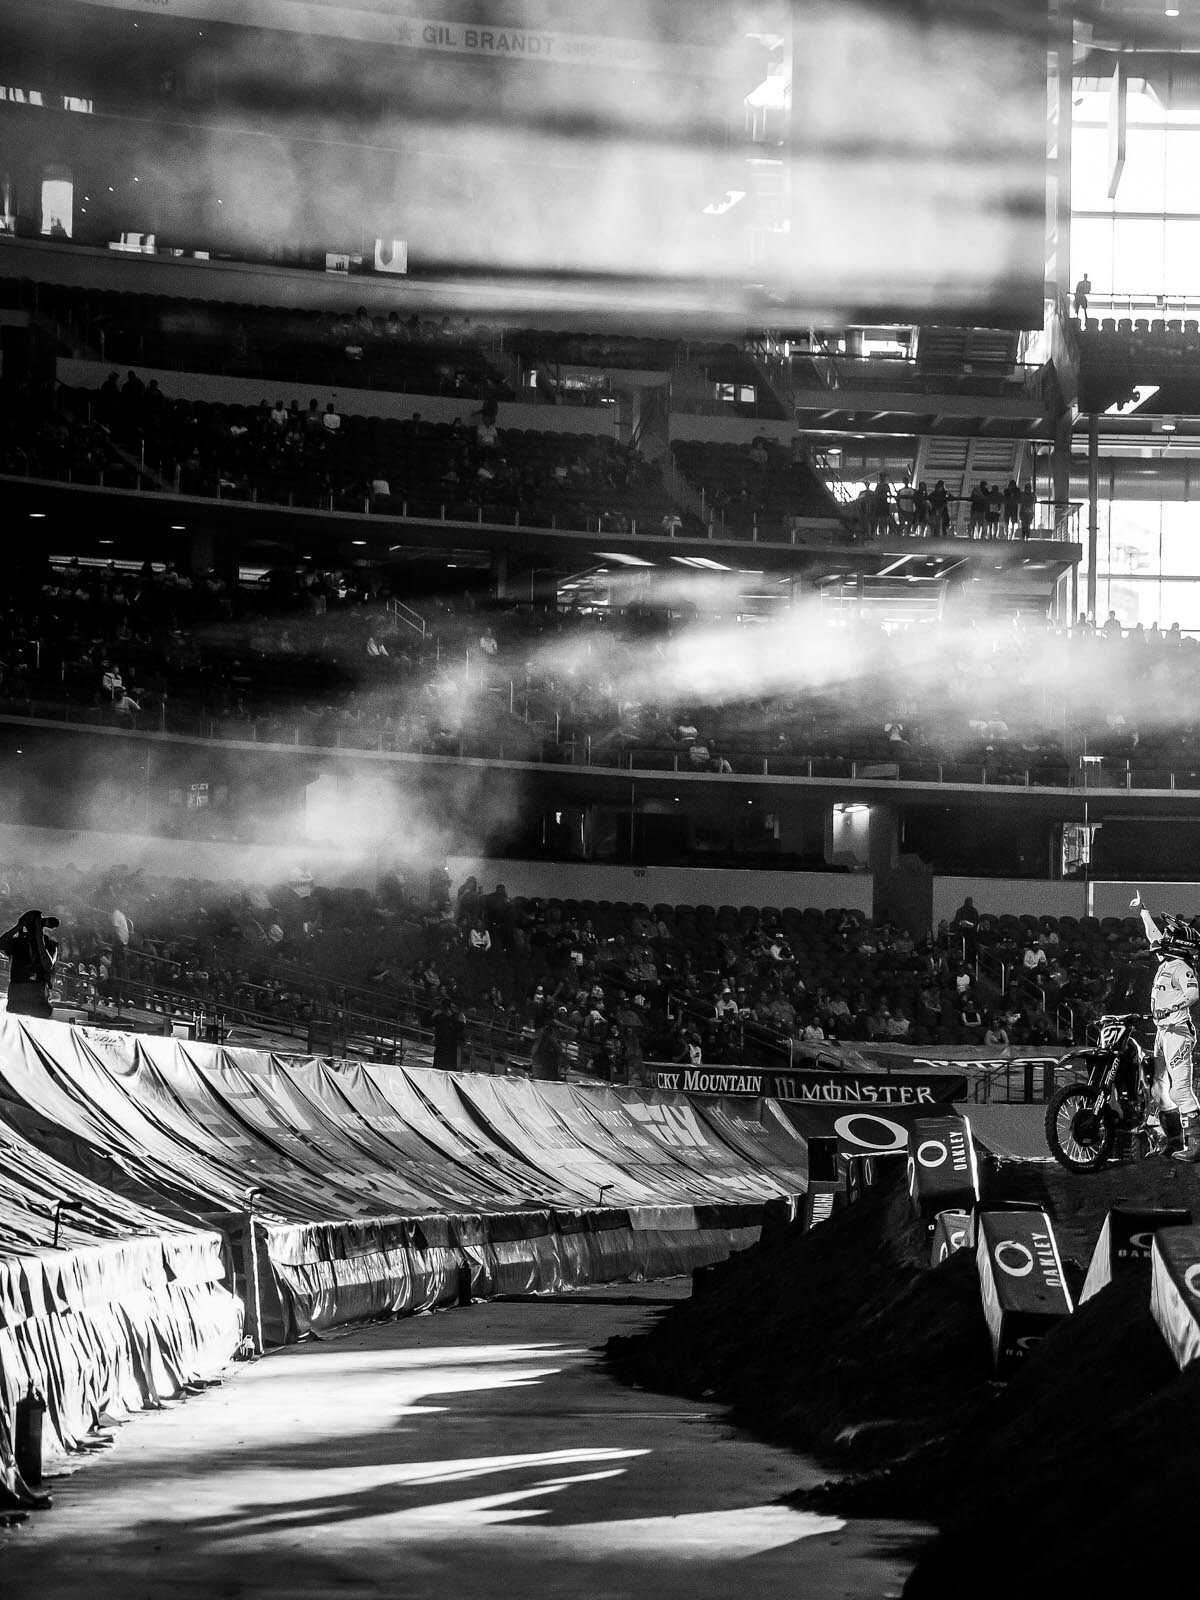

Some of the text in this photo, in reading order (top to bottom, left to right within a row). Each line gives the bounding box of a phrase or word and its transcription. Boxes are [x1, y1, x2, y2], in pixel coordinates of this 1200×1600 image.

[422, 25, 457, 46] GIL
[464, 30, 555, 55] BRANDT
[684, 1070, 762, 1092] MOUNTAIN
[949, 1130, 968, 1171] OAKLEY
[1031, 1232, 1064, 1288] OAKLEY
